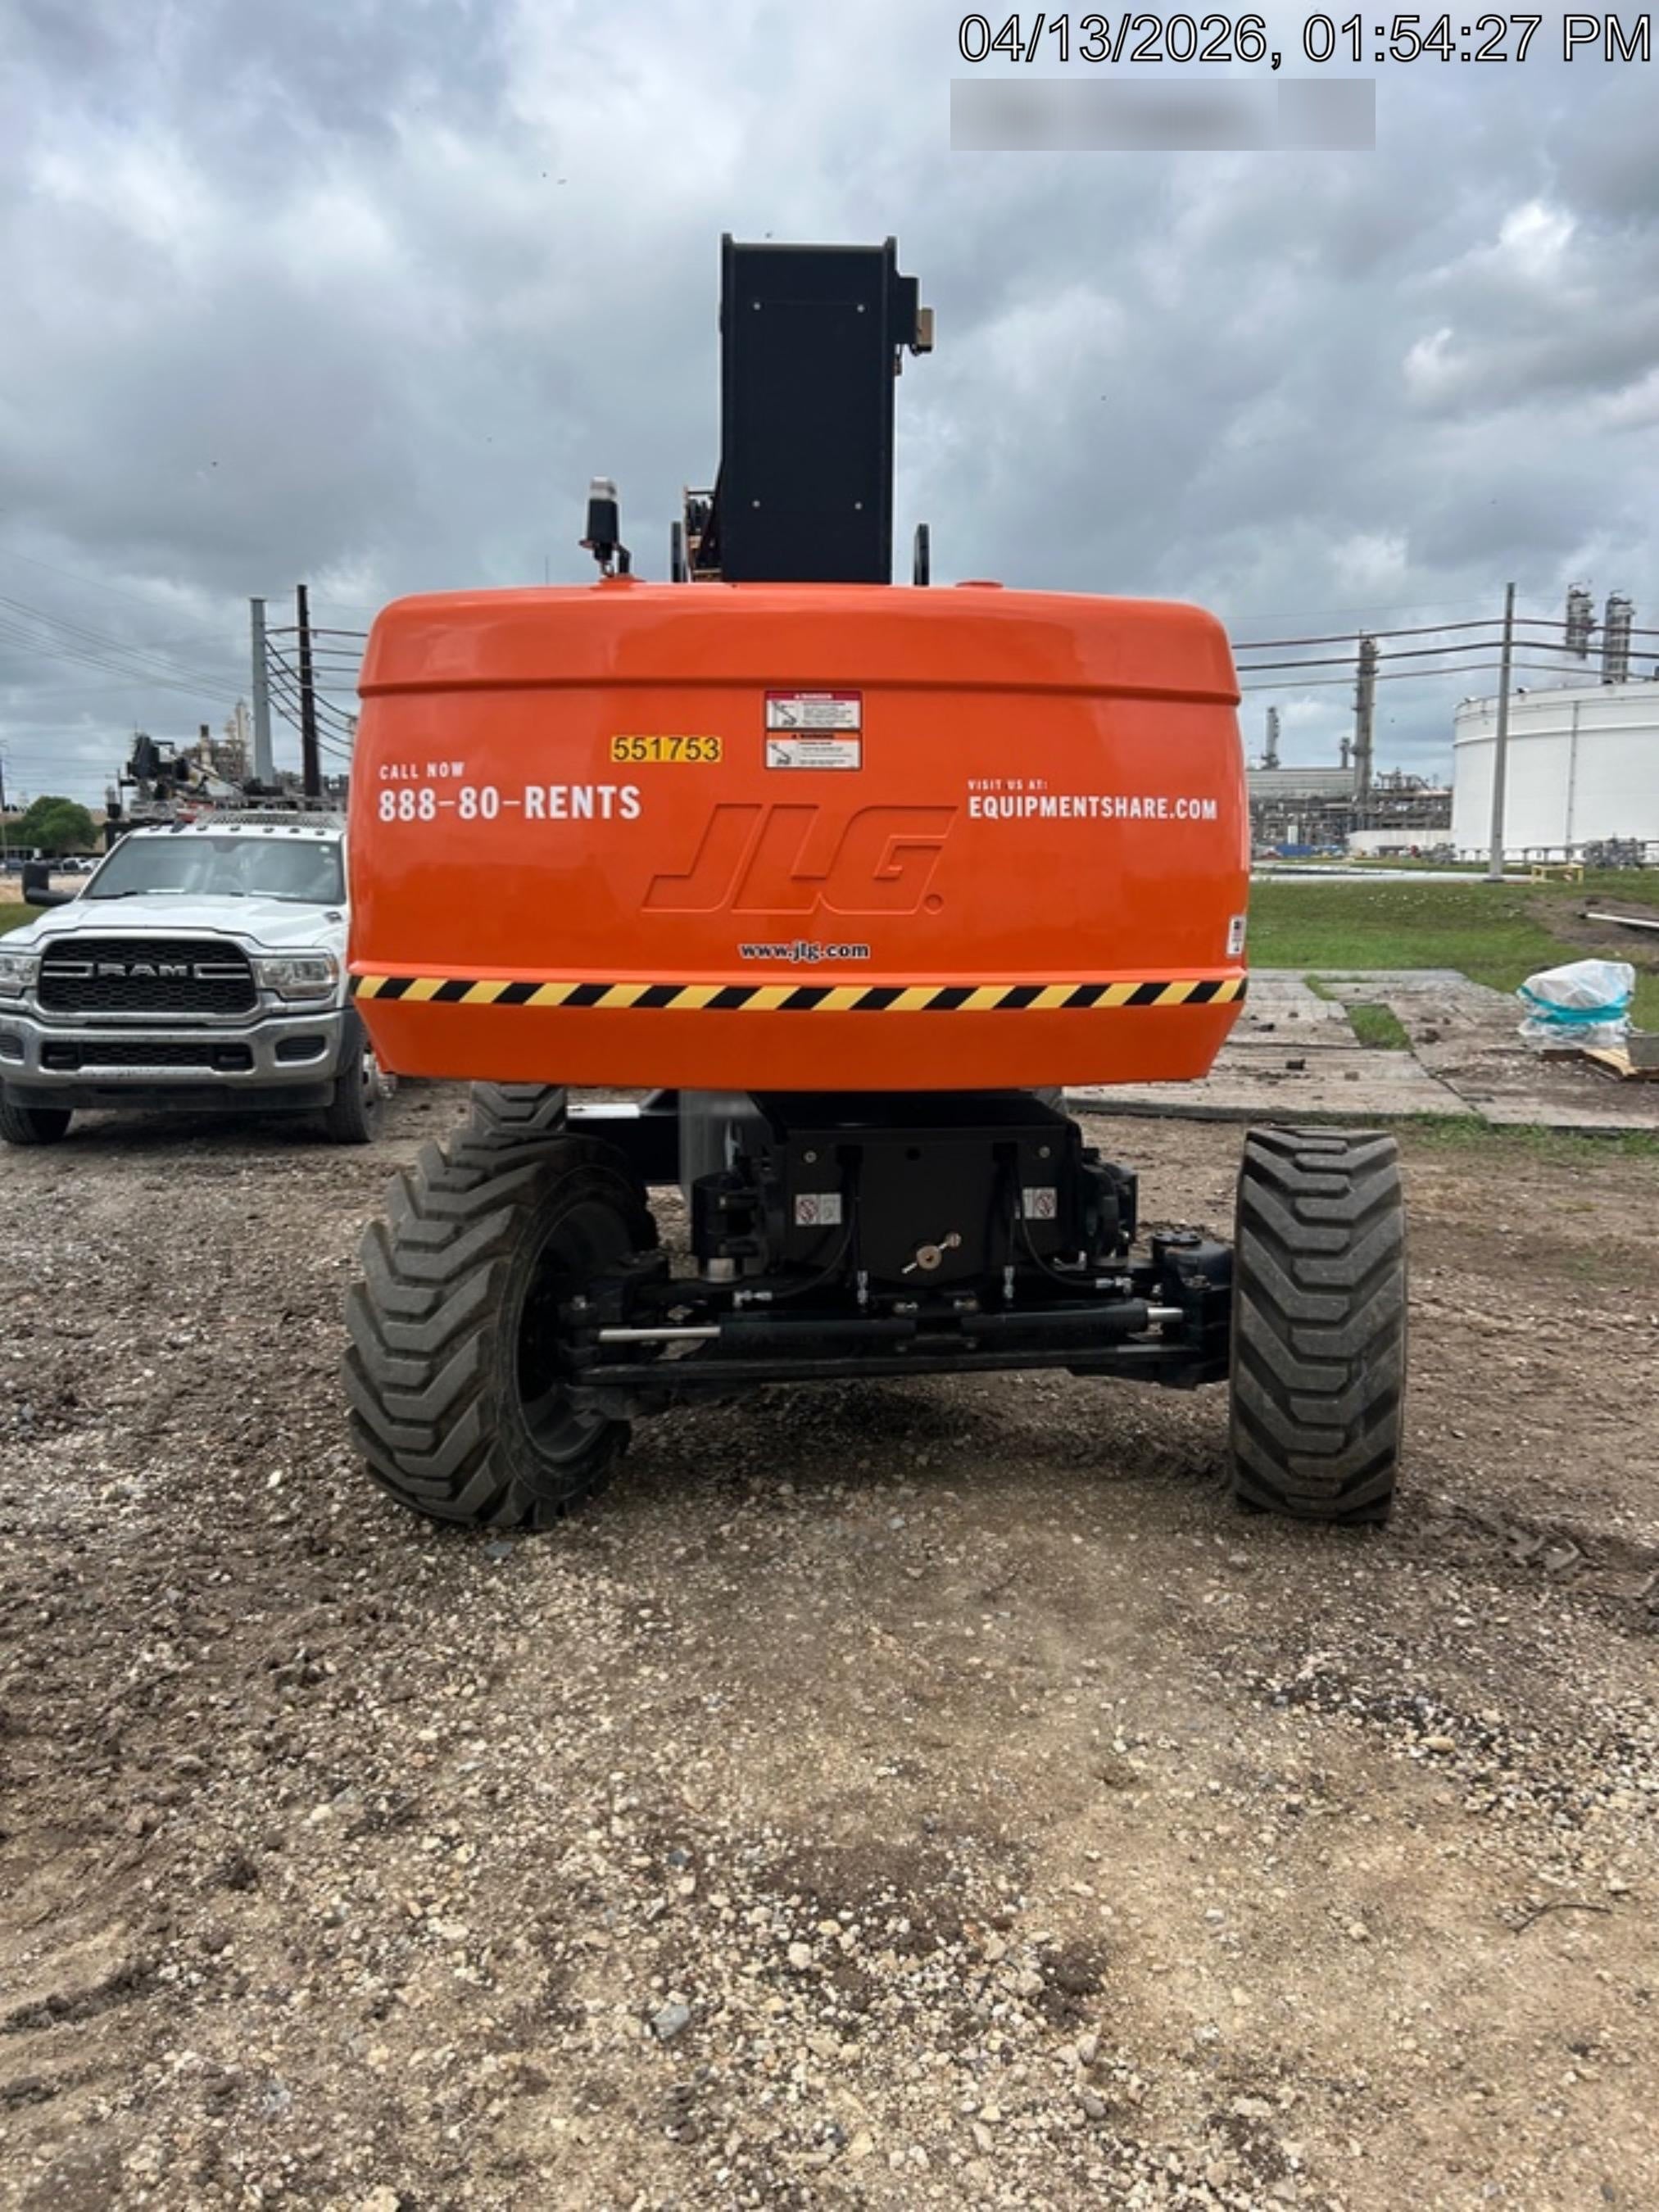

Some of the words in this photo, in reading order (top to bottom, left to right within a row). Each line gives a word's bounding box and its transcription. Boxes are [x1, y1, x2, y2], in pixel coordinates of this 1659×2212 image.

[614, 737, 720, 762] 551753
[378, 764, 419, 780] CALL
[427, 762, 465, 778] NOW
[968, 779, 1003, 791] VISIT
[1007, 779, 1024, 791] US
[1027, 779, 1049, 791] AT:
[378, 785, 641, 822] 888-80-RENTS
[968, 796, 1217, 820] EQUIPMENTSHARE.COM
[740, 941, 870, 963] www.jlg.com
[97, 962, 188, 977] RAM
